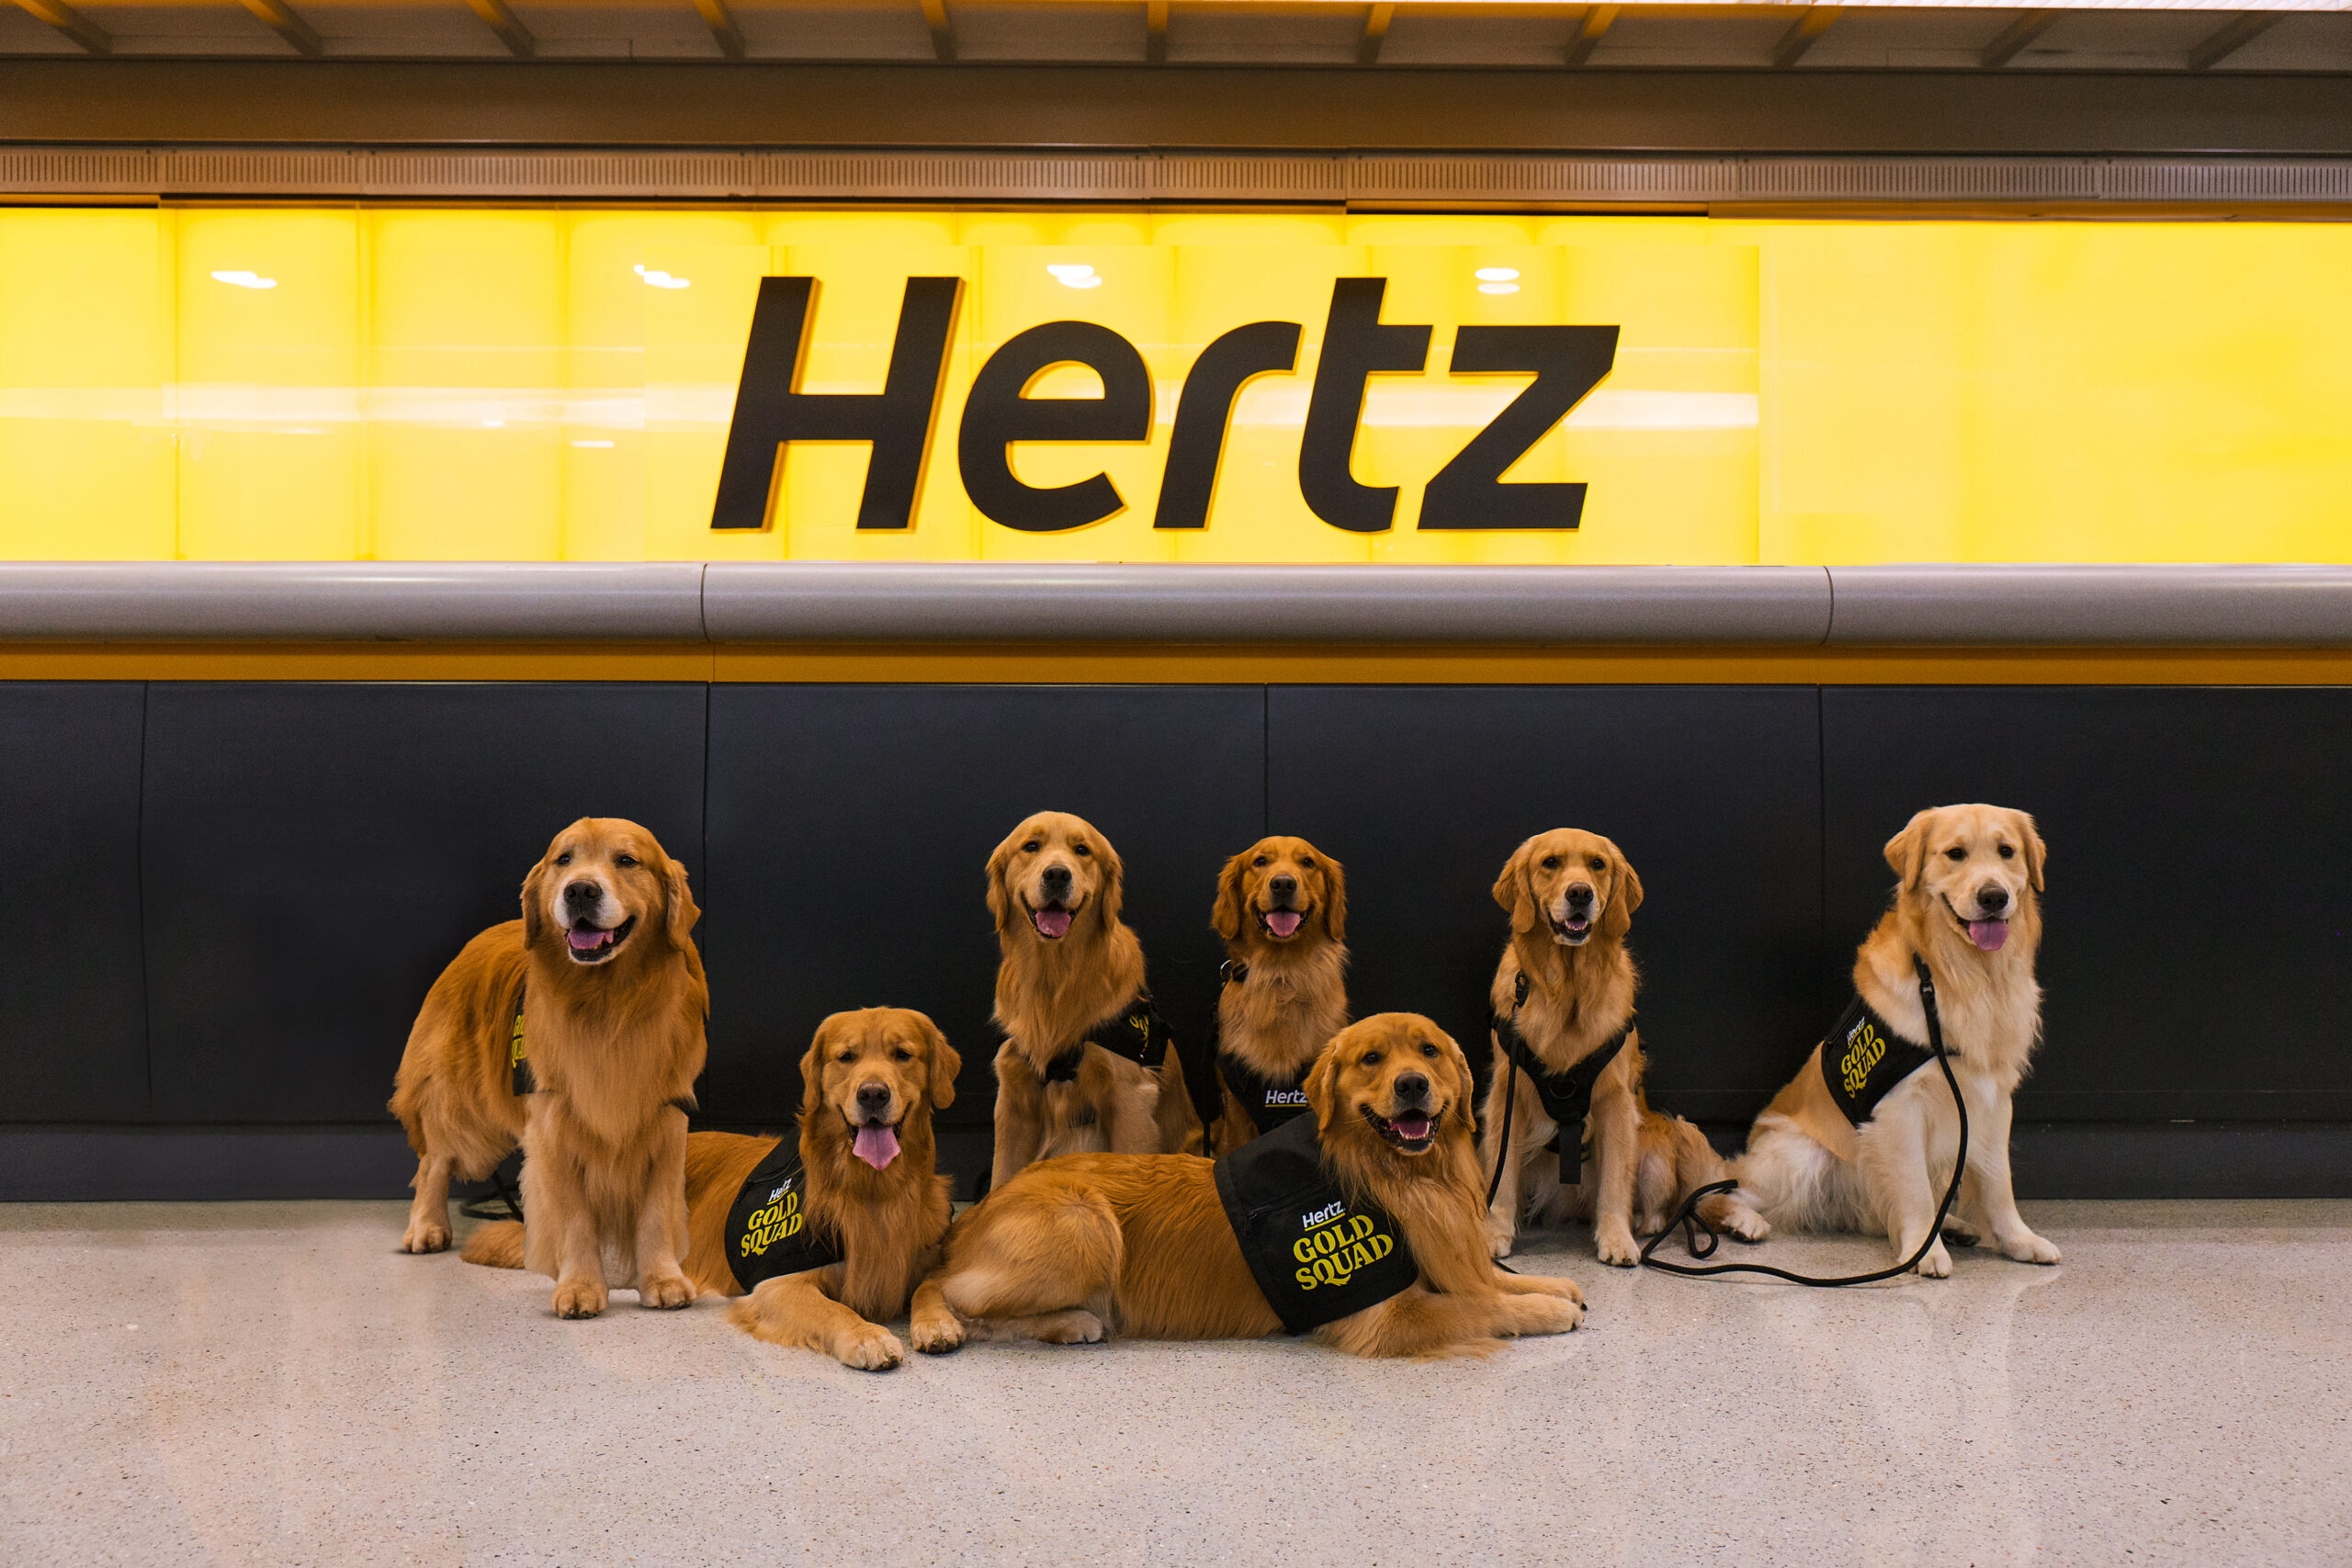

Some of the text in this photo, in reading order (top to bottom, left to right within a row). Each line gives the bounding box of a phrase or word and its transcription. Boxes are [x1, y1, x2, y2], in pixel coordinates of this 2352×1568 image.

[710, 275, 1620, 533] Hertz
[1841, 1024, 1874, 1076] GOLD
[1844, 1038, 1886, 1100] SQUAD
[1265, 1089, 1307, 1104] Hertz
[741, 1213, 803, 1258] SQUAD
[748, 1191, 798, 1231] GOLD
[1302, 1201, 1345, 1228] Hertz
[1293, 1214, 1374, 1263] GOLD
[1295, 1234, 1394, 1291] SQUAD
